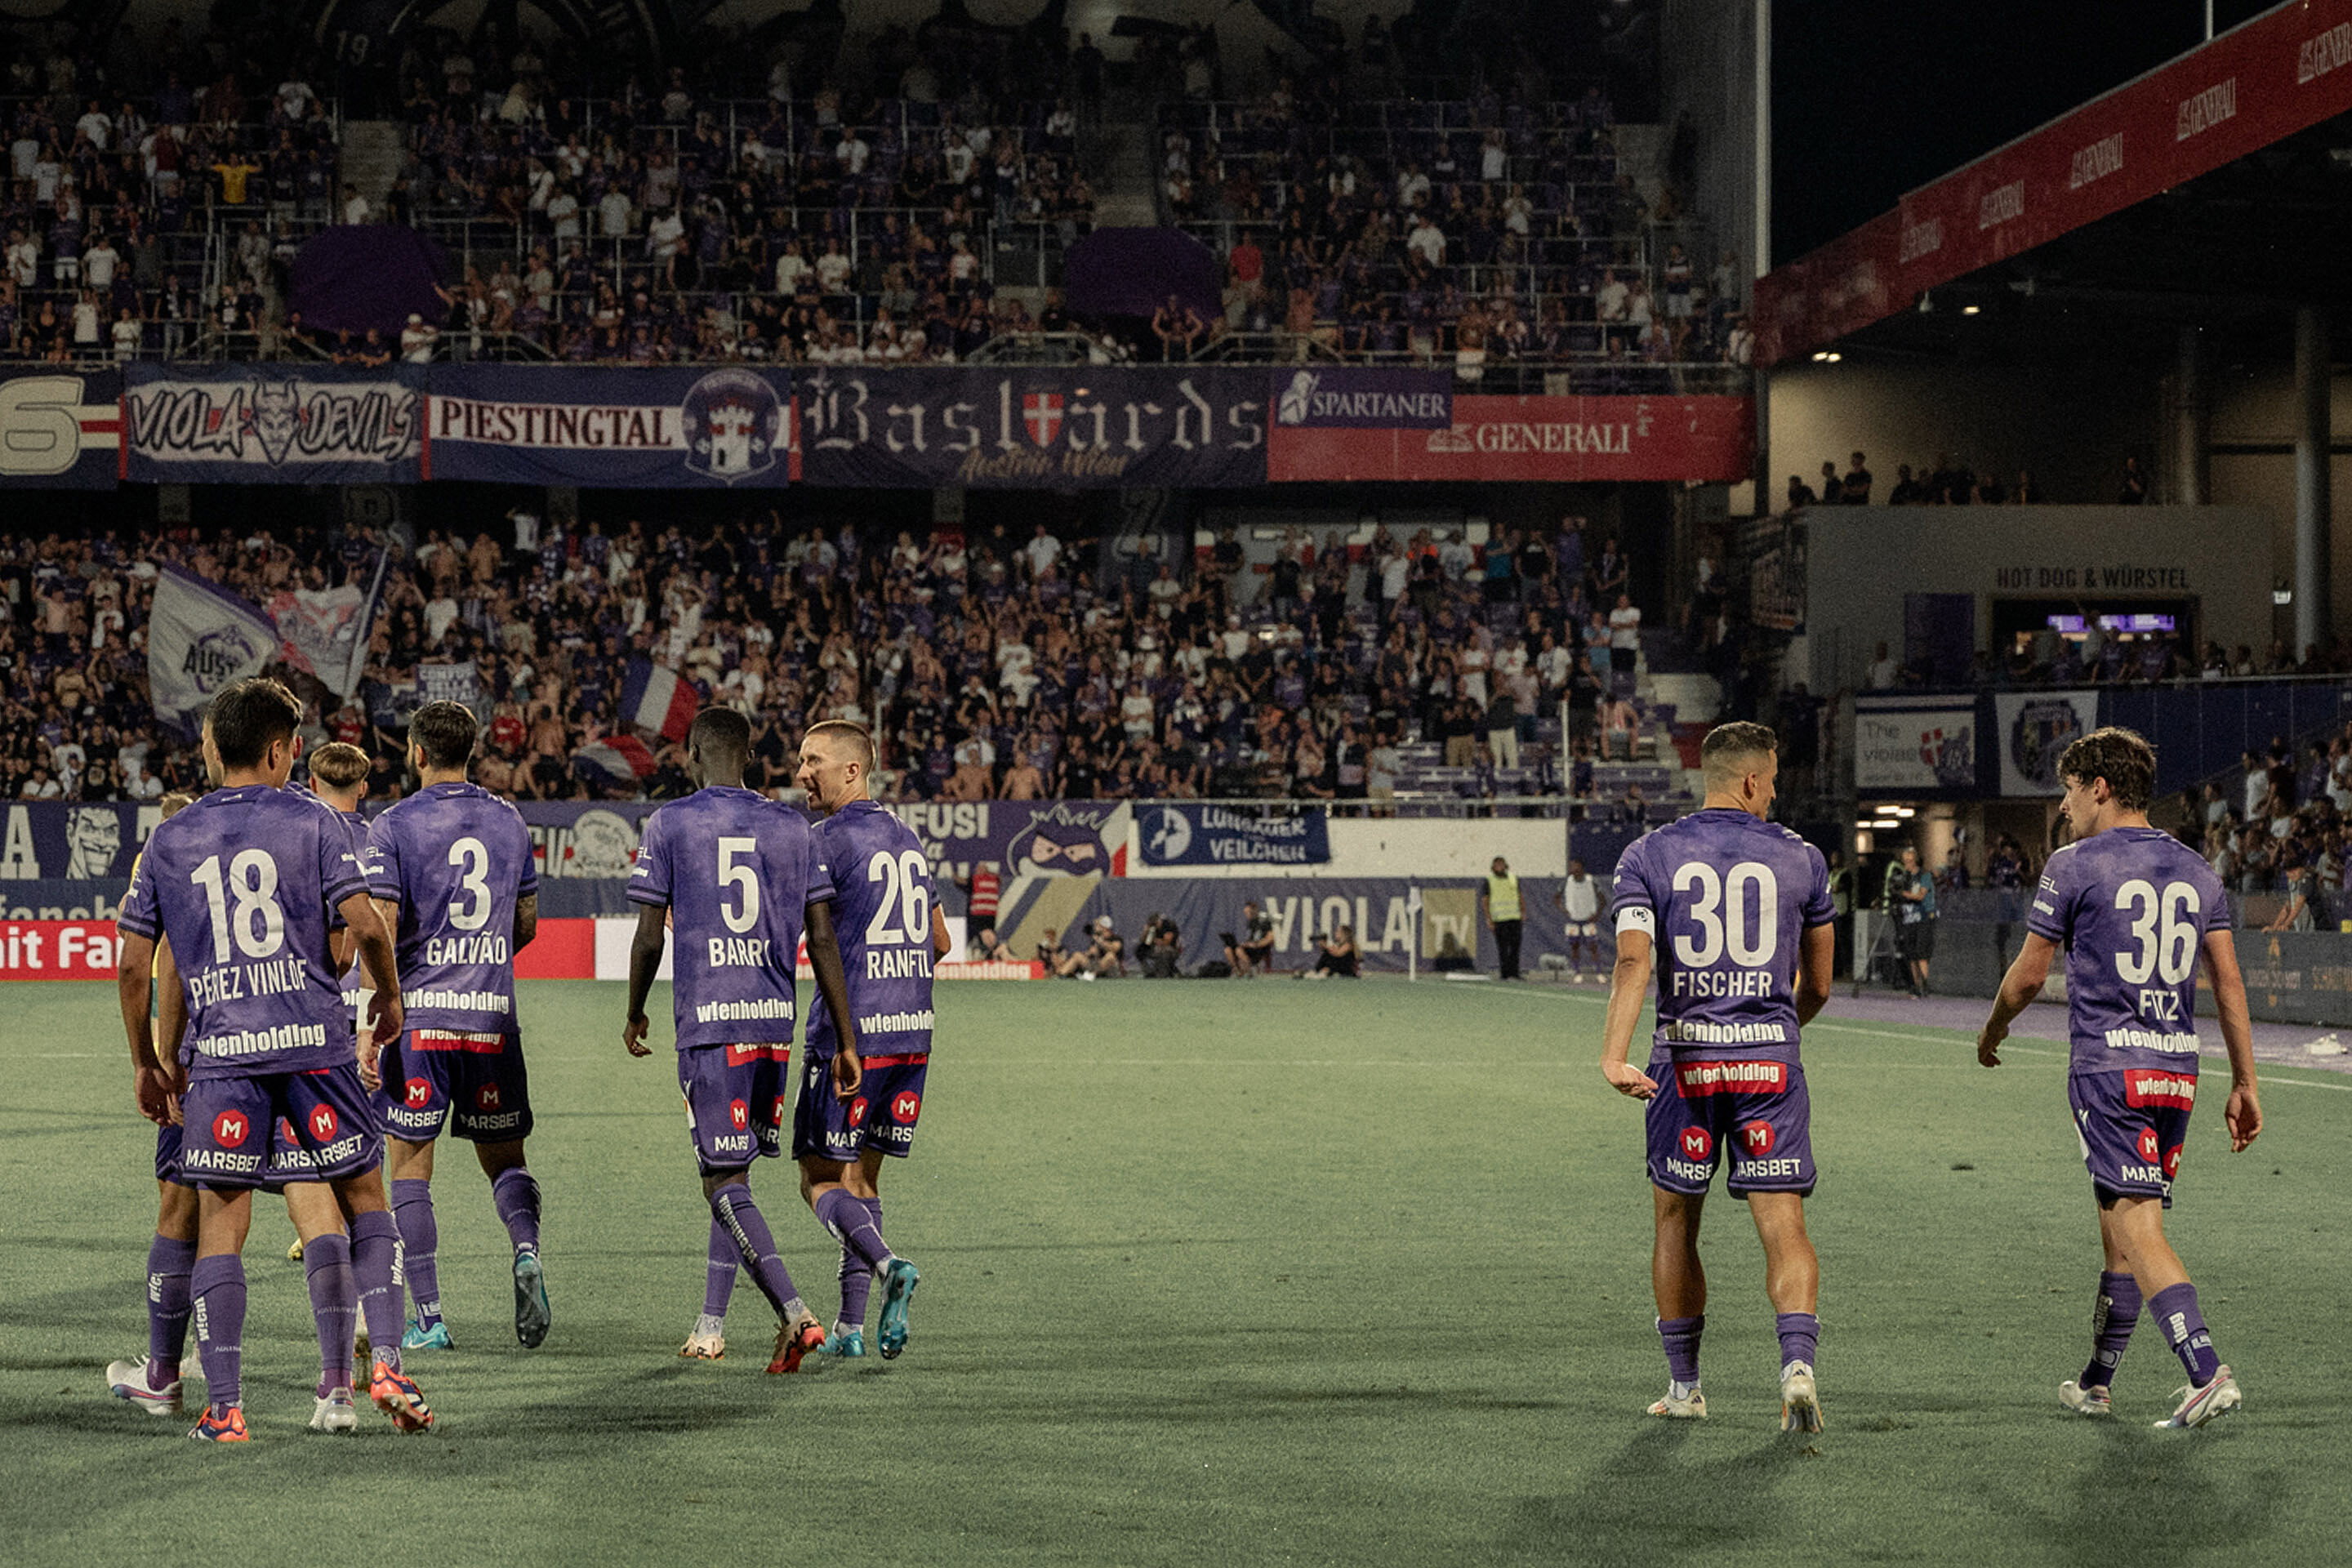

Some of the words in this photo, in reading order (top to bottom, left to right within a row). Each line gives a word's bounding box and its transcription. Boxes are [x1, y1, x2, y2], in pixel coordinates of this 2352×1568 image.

[1312, 391, 1446, 419] SPARTANER
[129, 388, 248, 457] VIOLA
[299, 390, 412, 461] DEVILS
[439, 399, 672, 447] PIESTINGTAL
[1477, 423, 1632, 454] GENERALI
[1998, 568, 2033, 589] HOT
[2041, 568, 2077, 589] DOG
[2084, 568, 2097, 589] &
[2103, 564, 2190, 589] WÜRSTEL
[1209, 838, 1307, 862] VEILCHEN
[448, 836, 492, 930] 3
[718, 836, 760, 933] 5
[866, 849, 929, 945] 26
[190, 849, 284, 964] 18
[1673, 862, 1778, 968] 30
[1264, 896, 1413, 953] VIOLA
[2114, 879, 2200, 985] 36
[426, 930, 507, 966] GALVÃO
[866, 948, 933, 980] RANFTL
[1674, 971, 1772, 998] FISCHER
[387, 1106, 444, 1128] MARSBET
[898, 1099, 915, 1116] M
[185, 1149, 261, 1173] MARSBET
[313, 1134, 363, 1167] ARSBET
